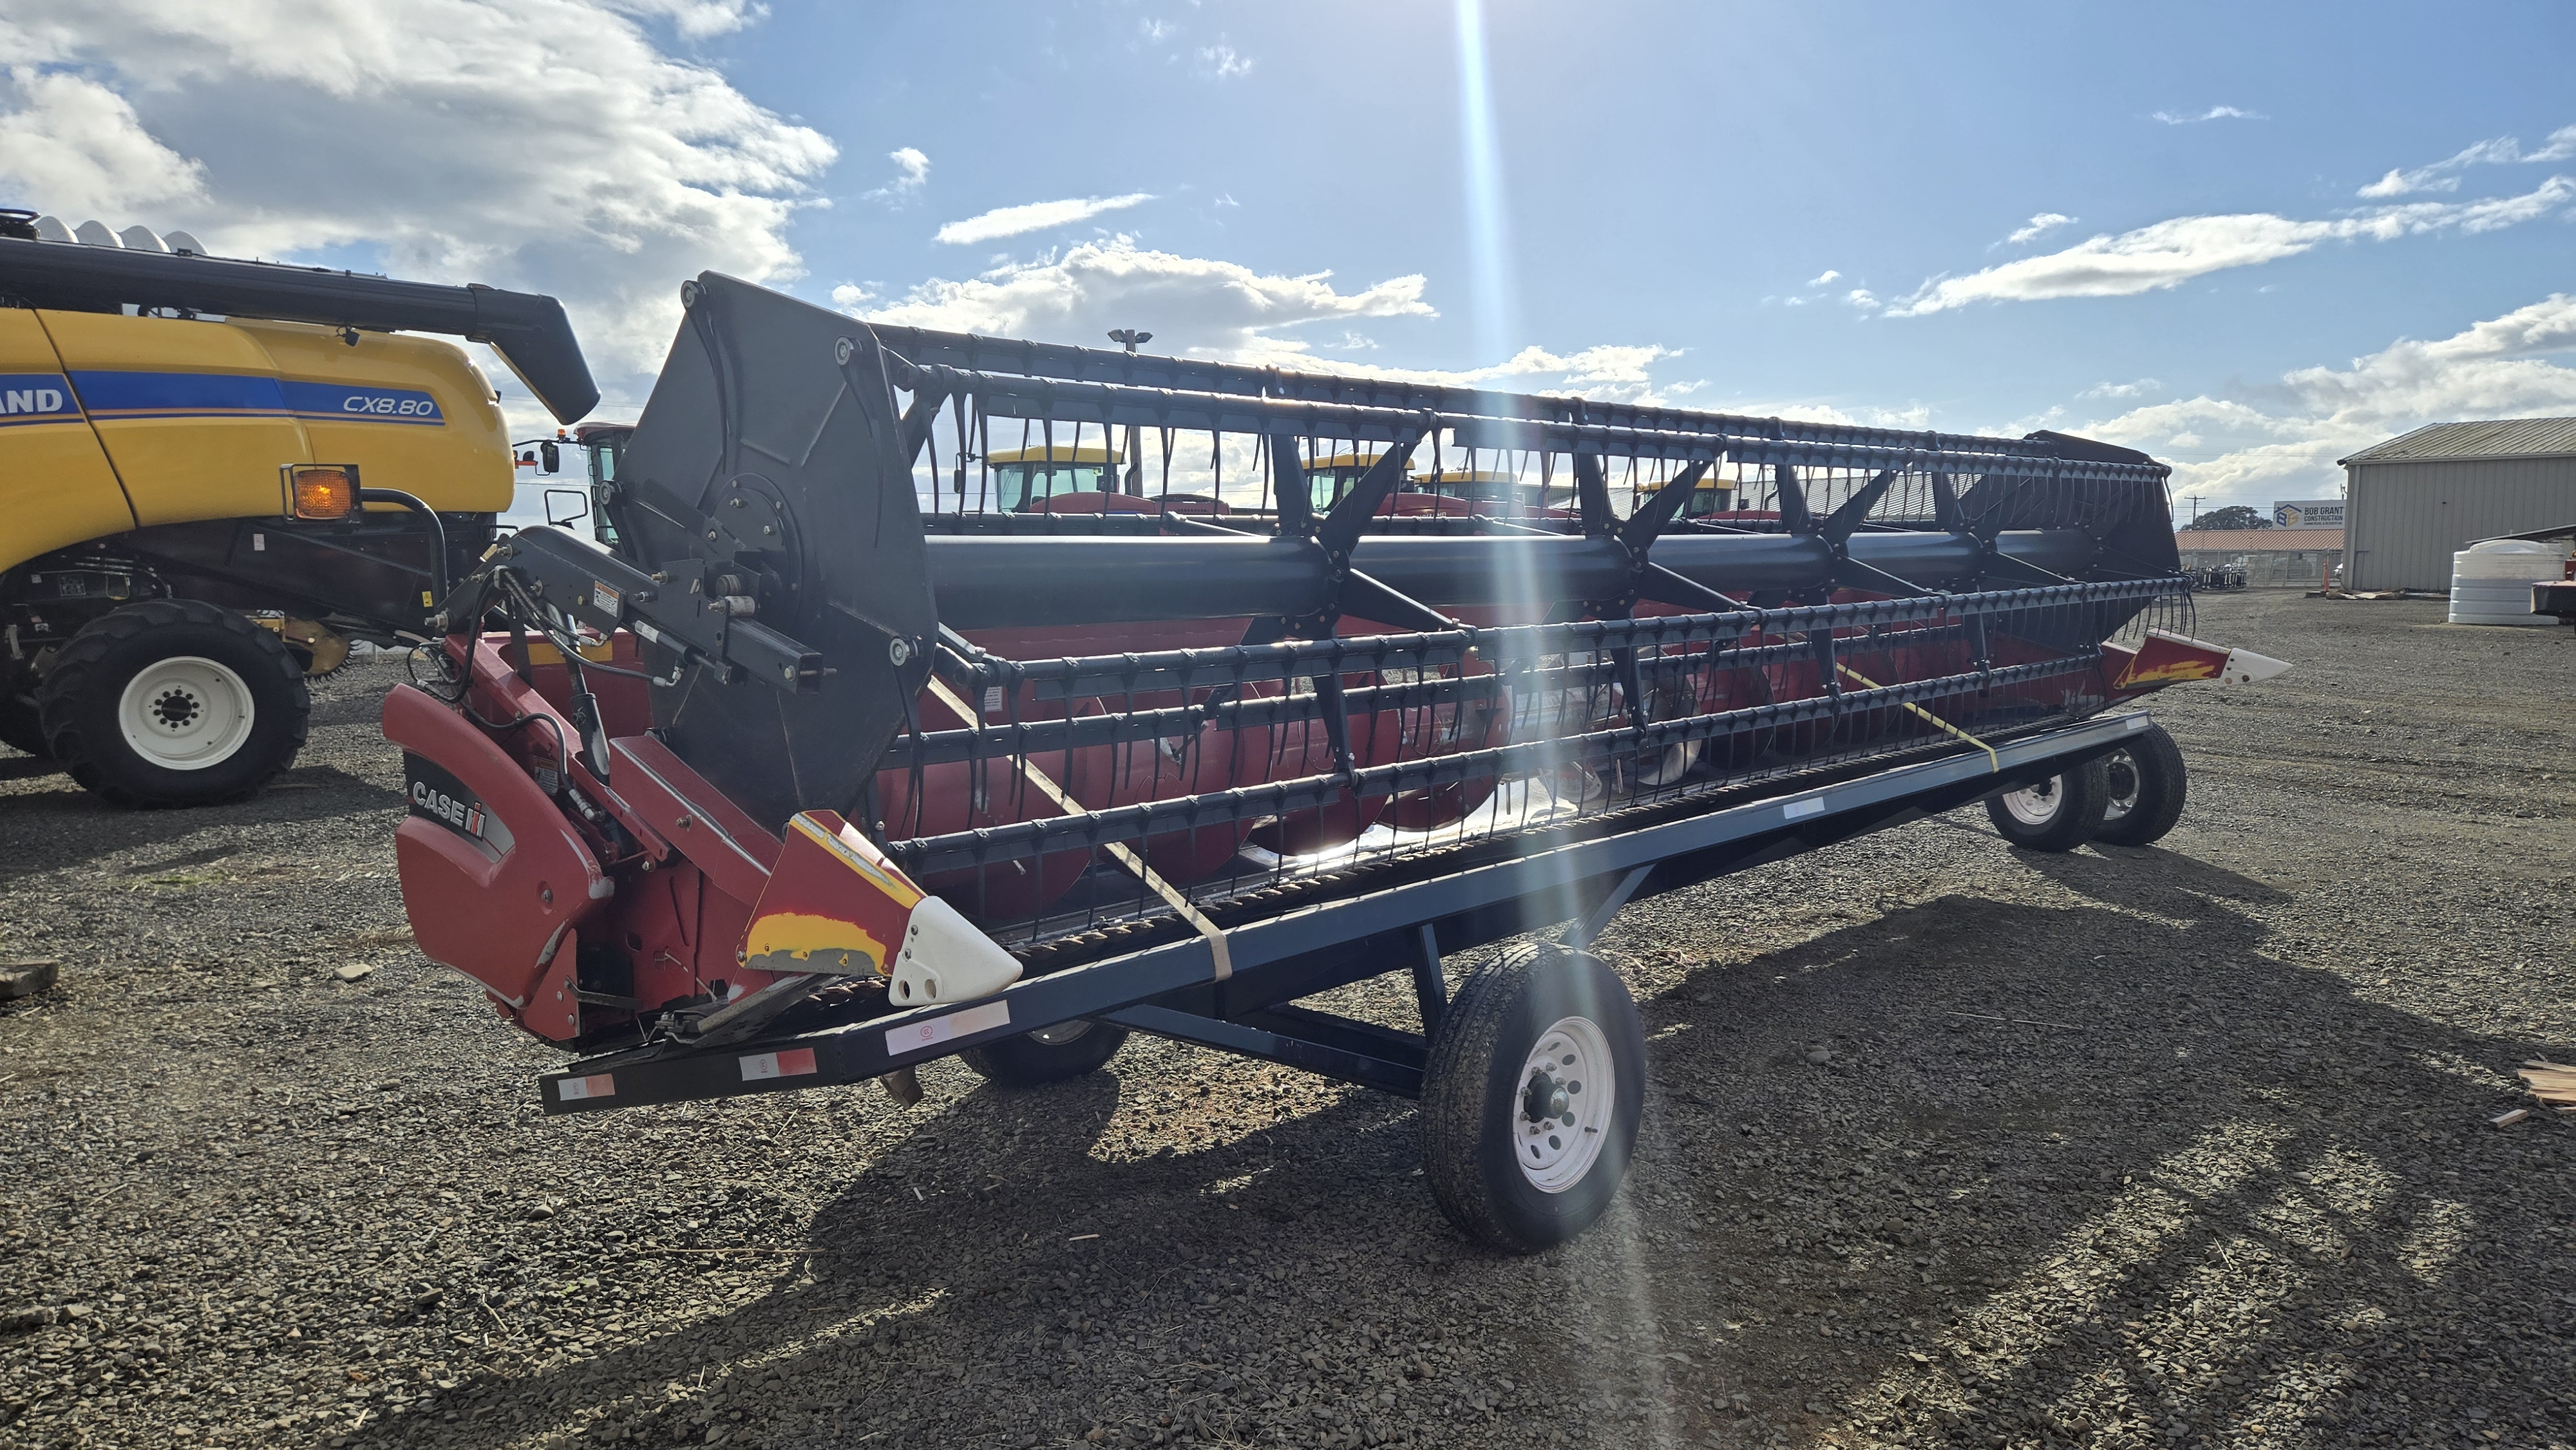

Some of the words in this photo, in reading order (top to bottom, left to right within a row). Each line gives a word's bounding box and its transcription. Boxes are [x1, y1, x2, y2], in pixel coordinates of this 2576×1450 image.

[343, 396, 433, 416] CX8.80
[2304, 507, 2318, 515] BOB
[2320, 506, 2344, 514] GRANT
[413, 781, 466, 827] CASE
